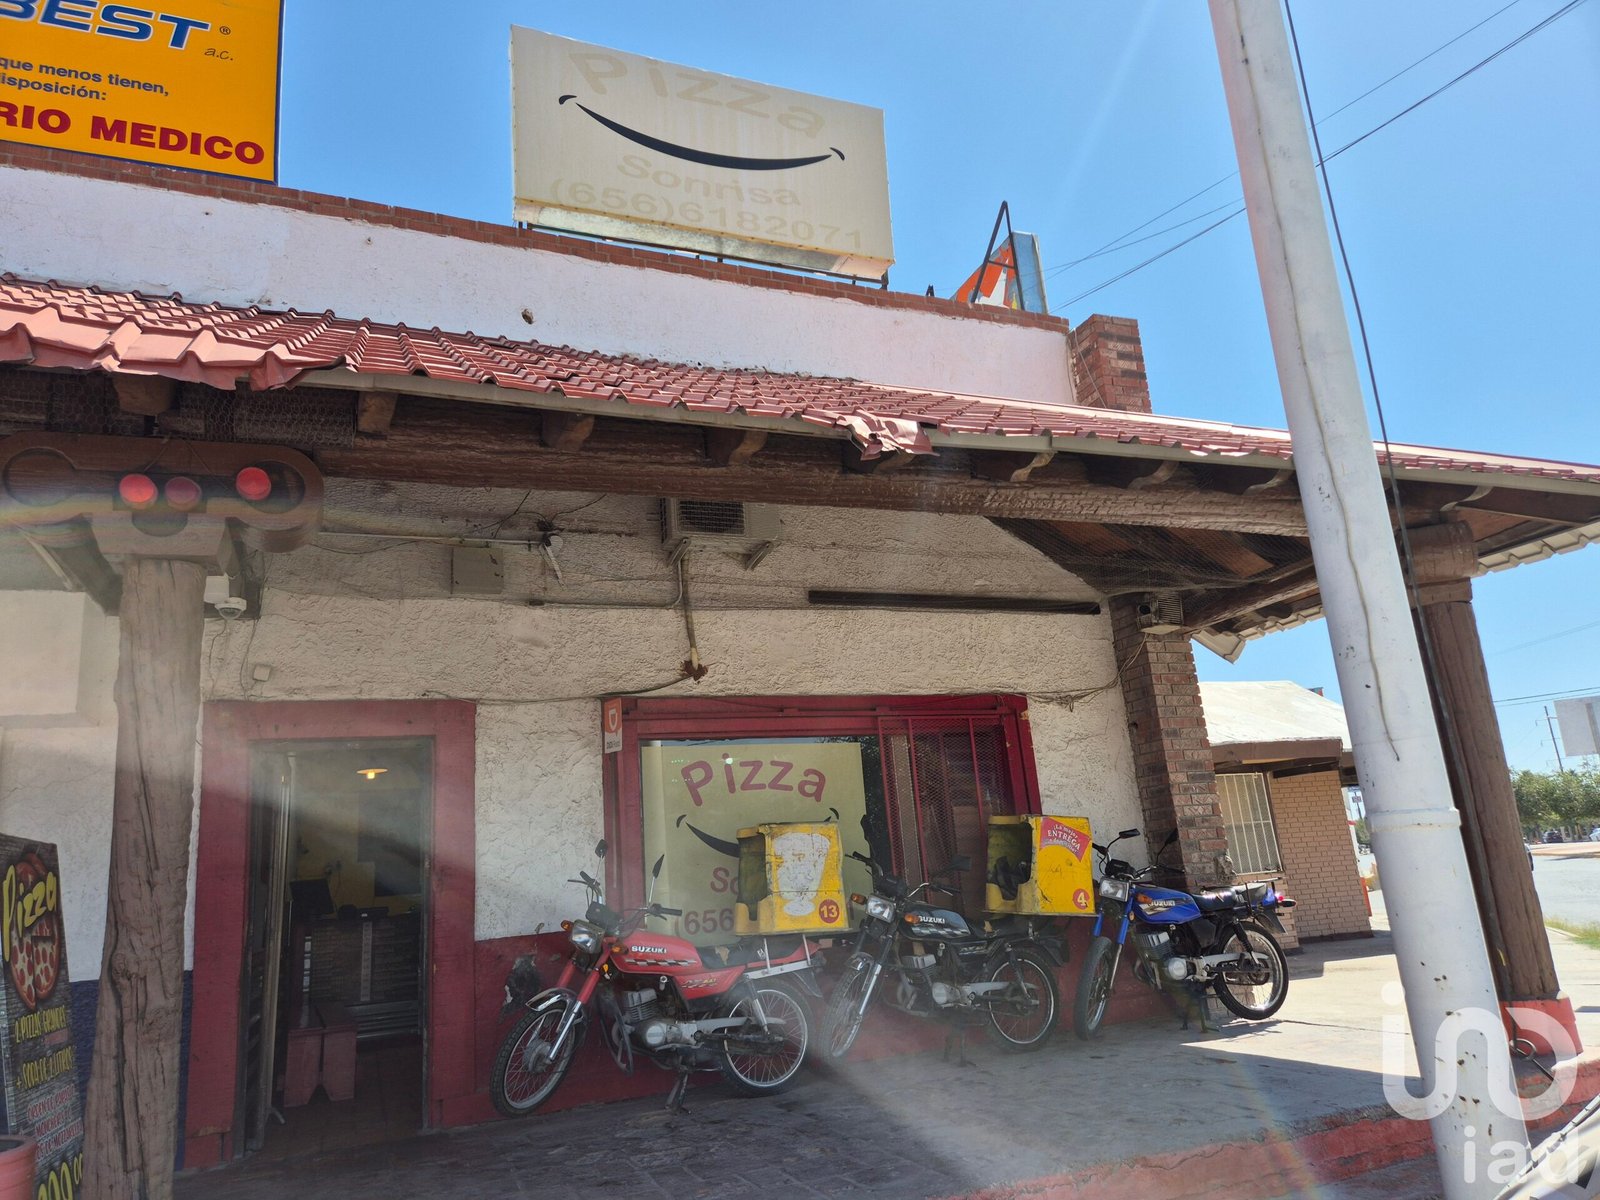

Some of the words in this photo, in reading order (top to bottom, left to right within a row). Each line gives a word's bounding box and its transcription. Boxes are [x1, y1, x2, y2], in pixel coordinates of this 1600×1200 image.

[204, 47, 234, 61] a.c.
[0, 56, 33, 71] que
[39, 64, 102, 83] menos
[108, 73, 169, 97] tienen,
[0, 72, 107, 100] isposición:
[568, 52, 827, 140] Pizza
[91, 115, 265, 165] MEDICO
[616, 154, 801, 206] Sonrisa
[550, 177, 862, 249] (656)6182071
[681, 752, 827, 807] Pizza
[1047, 829, 1081, 851] ENTREGA
[820, 904, 838, 920] 13
[1077, 891, 1087, 906] 4
[631, 945, 667, 954] SUZUKI
